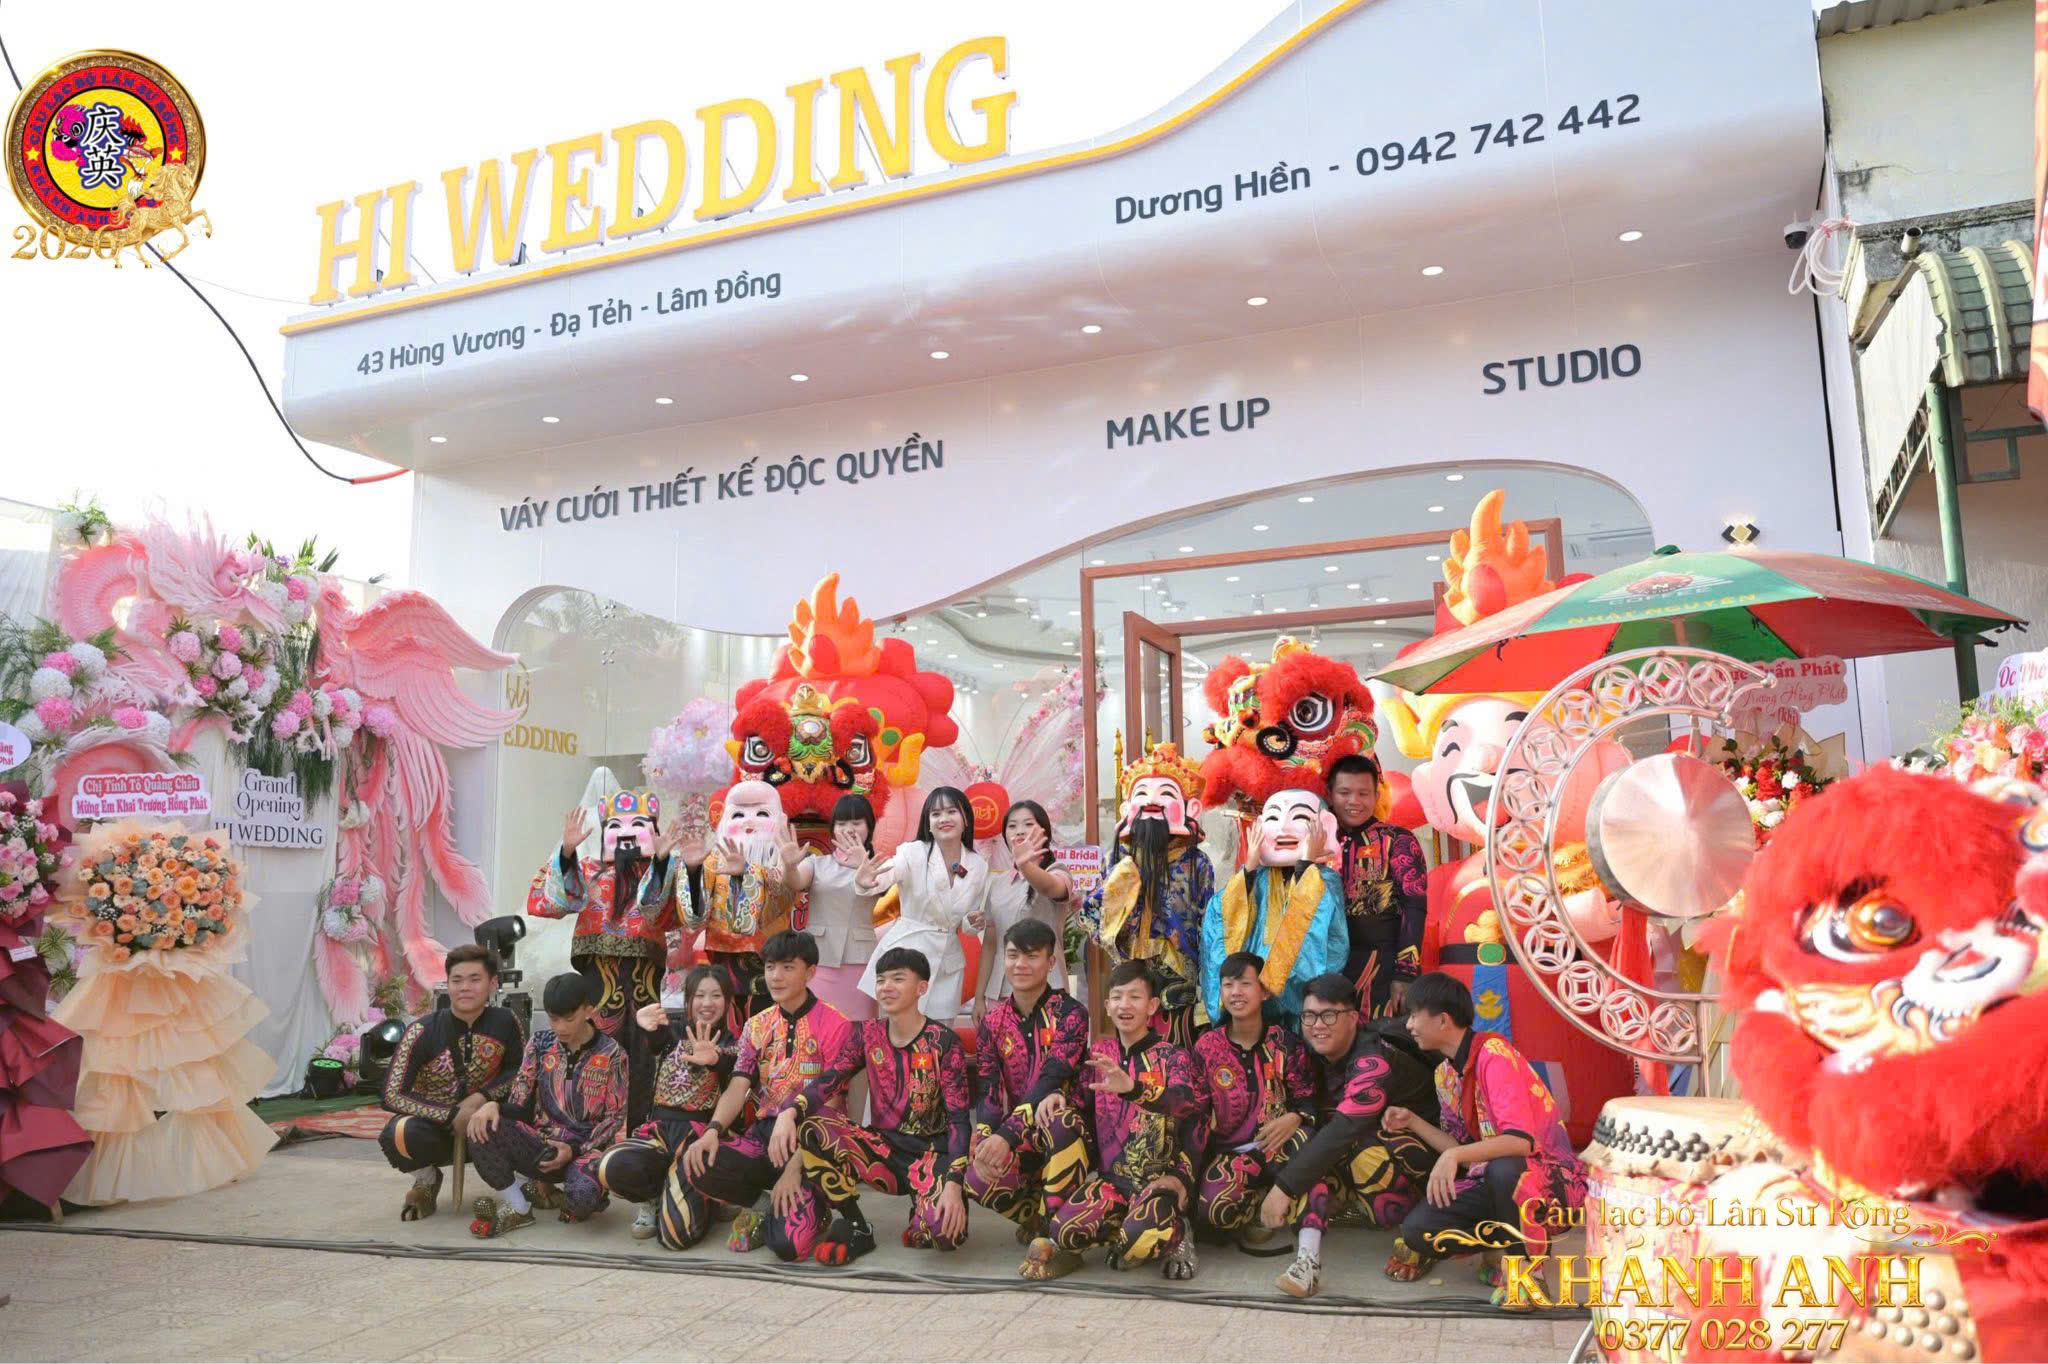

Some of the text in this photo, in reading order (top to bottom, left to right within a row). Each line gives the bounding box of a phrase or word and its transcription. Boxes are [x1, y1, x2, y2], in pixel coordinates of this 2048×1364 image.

[309, 36, 1018, 305] HI WEDDING
[1116, 185, 1222, 224] Dương
[1356, 131, 1456, 176] 0942
[1471, 113, 1544, 154] 742
[1558, 94, 1640, 134] 442
[357, 351, 383, 375] 43
[390, 343, 444, 369] Hùng
[453, 326, 524, 355] Vương
[550, 312, 580, 337] Đạ
[588, 298, 631, 328] Tẻh
[657, 288, 707, 314] Lâm
[715, 270, 780, 303] Đồng
[1483, 344, 1641, 395] STUDIO
[1107, 398, 1270, 449] MAKE UP
[500, 433, 943, 531] VÁY CƯỚI THIẾT KẾ ĐỘC QUYỀN
[1801, 661, 1842, 677] Phát
[504, 722, 577, 756] EDDING
[244, 772, 294, 795] Grand
[101, 799, 115, 813] Em
[117, 798, 136, 813] Khai
[237, 790, 301, 821] Opening
[238, 823, 322, 844] WEDDING
[1069, 848, 1099, 862] Bridal
